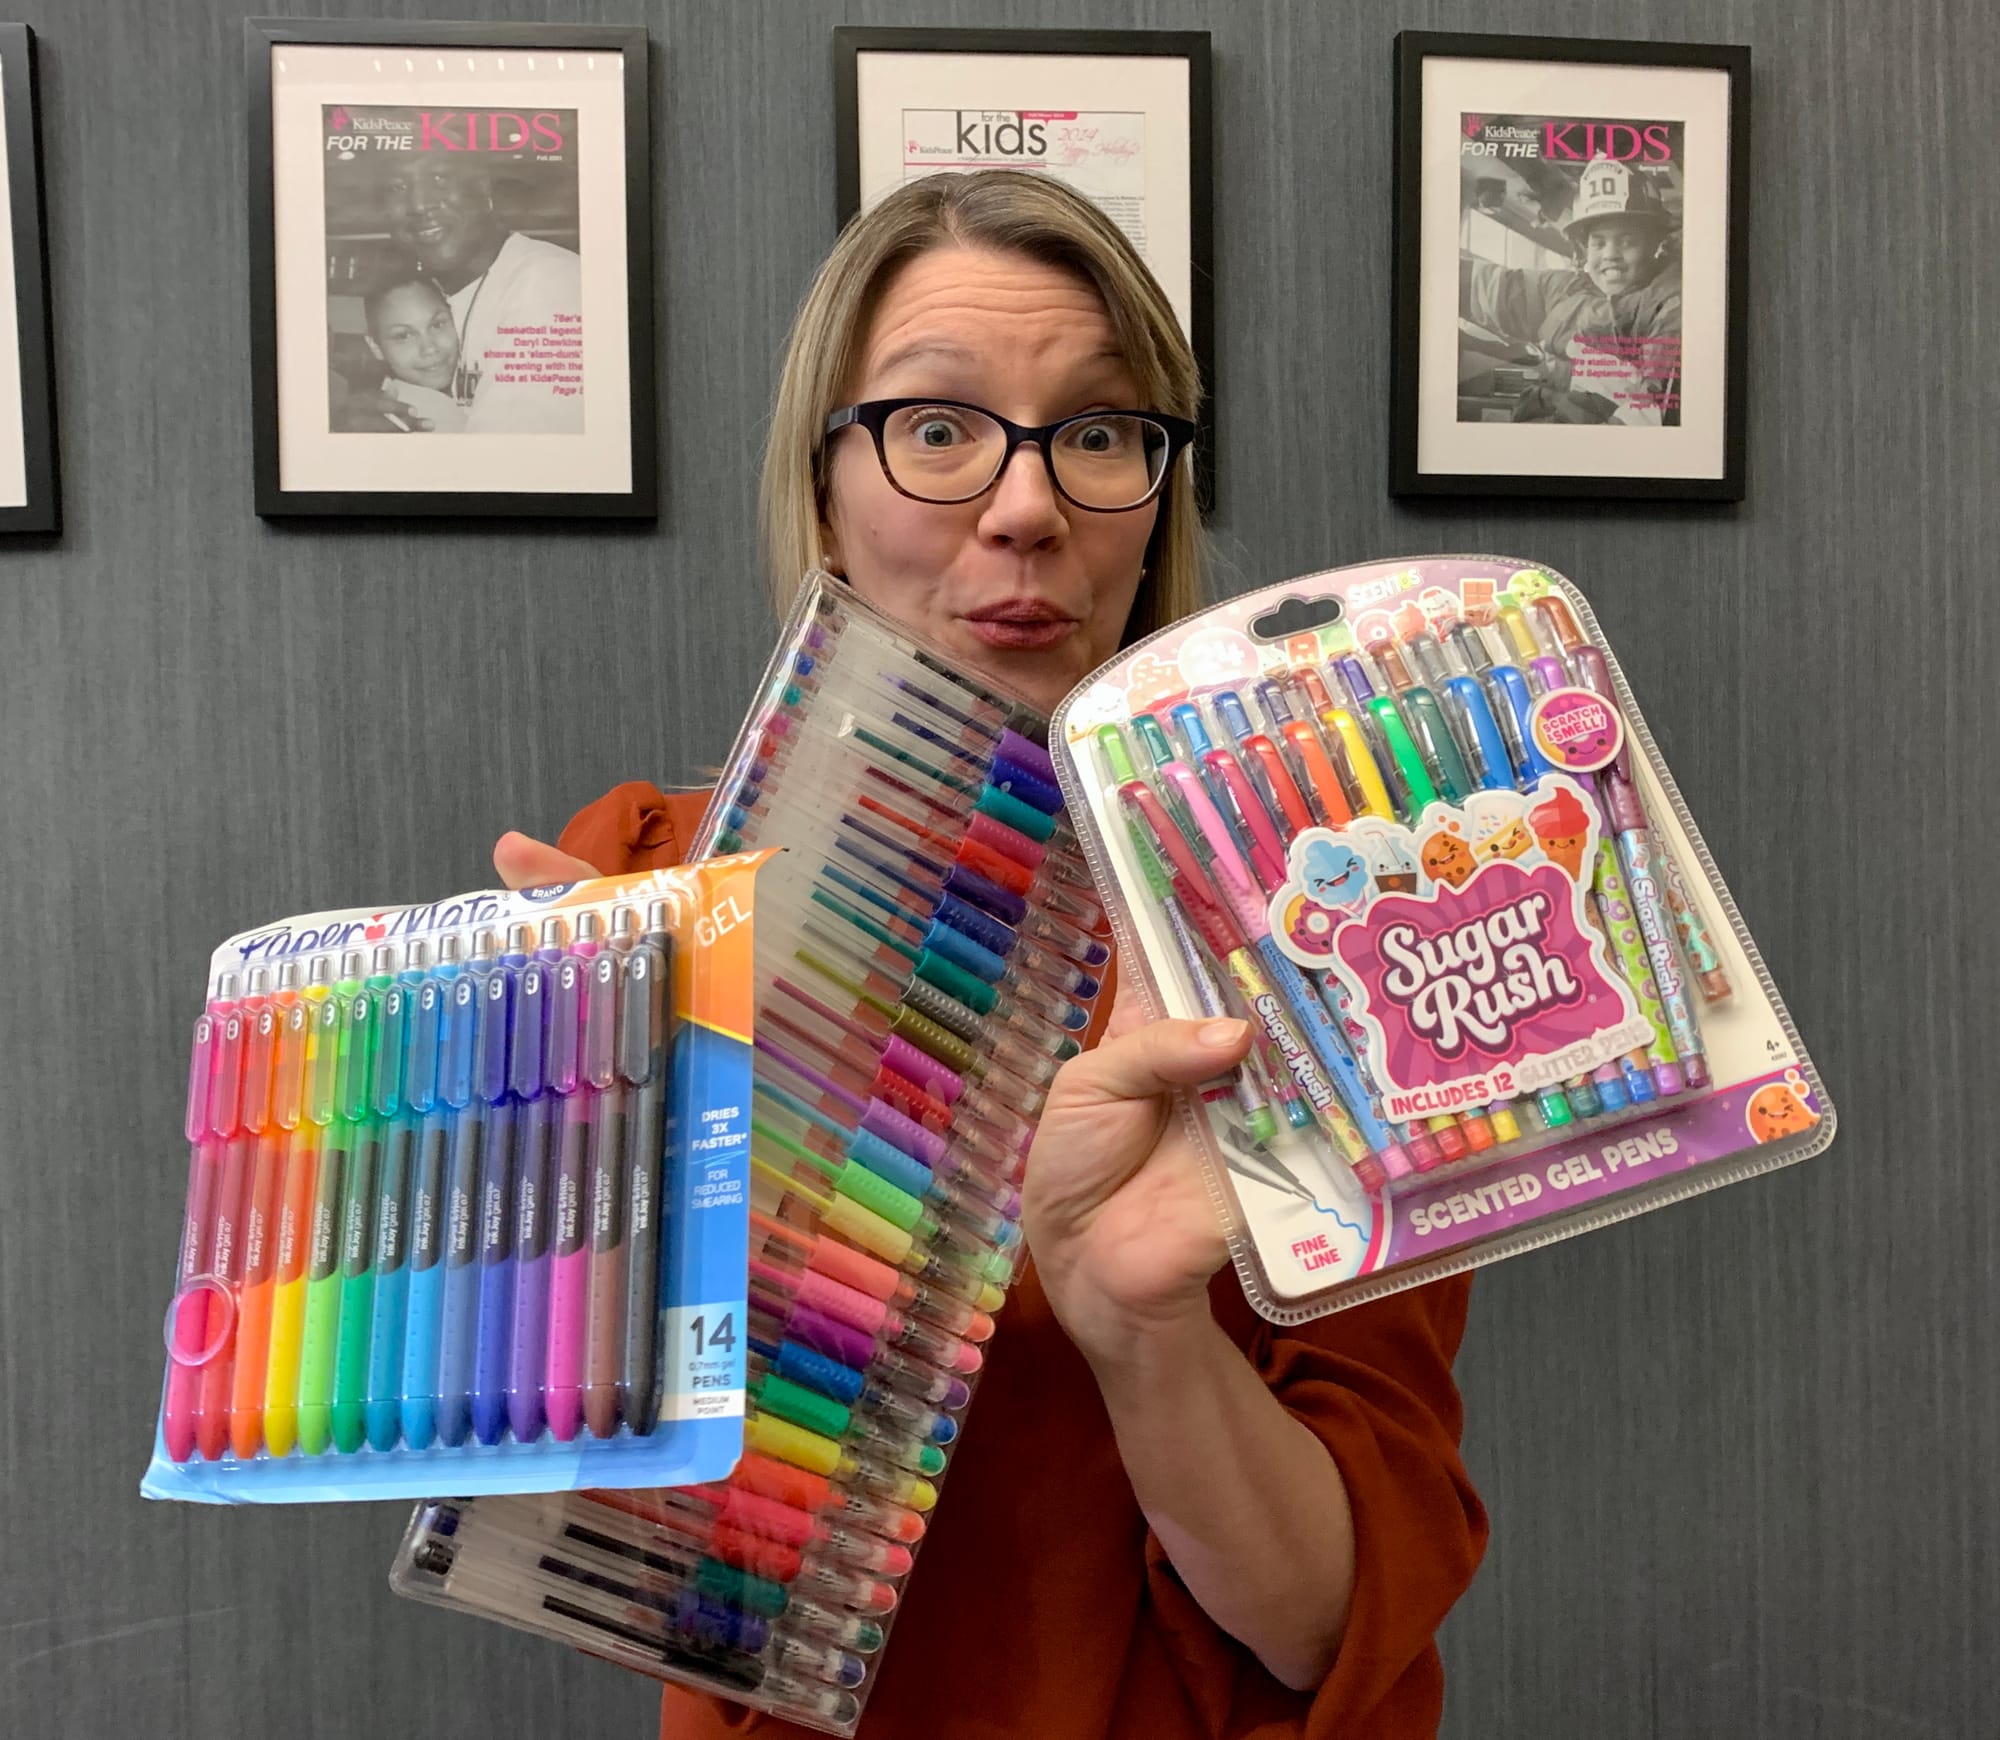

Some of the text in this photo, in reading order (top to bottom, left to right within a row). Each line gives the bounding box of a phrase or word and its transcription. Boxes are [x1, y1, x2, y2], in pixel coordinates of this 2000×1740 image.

[353, 118, 411, 130] KidsPeace
[981, 111, 1010, 122] for the
[326, 112, 563, 152] FOR THE KIDS
[957, 111, 1047, 155] kids
[1461, 121, 1671, 162] FOR THE KIDS
[1485, 126, 1538, 139] KidsPeace
[1589, 177, 1616, 198] 10
[497, 326, 582, 336] basketball legend
[513, 338, 582, 348] Daryl Dawkins
[484, 350, 516, 358] shares
[504, 362, 583, 372] evening with the
[495, 374, 515, 382] kids
[519, 374, 528, 382] at
[553, 386, 577, 396] Page
[1543, 706, 1600, 732] SCRATCH
[1553, 716, 1605, 742] SMELL!
[531, 884, 564, 899] BRAND
[694, 895, 753, 949] GEL
[1383, 894, 1546, 996] Sugar
[1634, 877, 1680, 998] Sugar Rush
[1411, 943, 1577, 1049] Rush
[1255, 993, 1297, 1059] Sugar
[1288, 1053, 1334, 1110] Rush
[1766, 1040, 1780, 1051] 4+
[1390, 1079, 1489, 1116] INCLUDES
[1495, 1072, 1515, 1092] 12
[1519, 1047, 1599, 1084] GLITTER
[1604, 1023, 1652, 1053] PENS
[701, 1106, 740, 1123] DRIES
[712, 1122, 728, 1134] 3X
[694, 1180, 741, 1196] REDUCED
[708, 1169, 728, 1181] FOR
[1409, 1128, 1679, 1237] SCENTED GEL PENS
[639, 1200, 649, 1228] InkJoy
[691, 1193, 743, 1209] SMEARING
[524, 1211, 534, 1238] InkJoy
[567, 1209, 576, 1237] InkJoy
[601, 1202, 611, 1231] InkJoy
[387, 1229, 397, 1256] InkJoy
[420, 1223, 430, 1250] InkJoy
[458, 1222, 468, 1249] InkJoy
[491, 1217, 501, 1244] InkJoy
[319, 1235, 330, 1262] InkJoy
[352, 1231, 361, 1258] InkJoy
[1291, 1235, 1330, 1259] FINE
[1303, 1247, 1341, 1272] LINE
[690, 1312, 736, 1356] 14
[692, 1374, 731, 1389] PENS
[693, 1396, 729, 1406] MEDIUM
[697, 1406, 724, 1415] POINT
